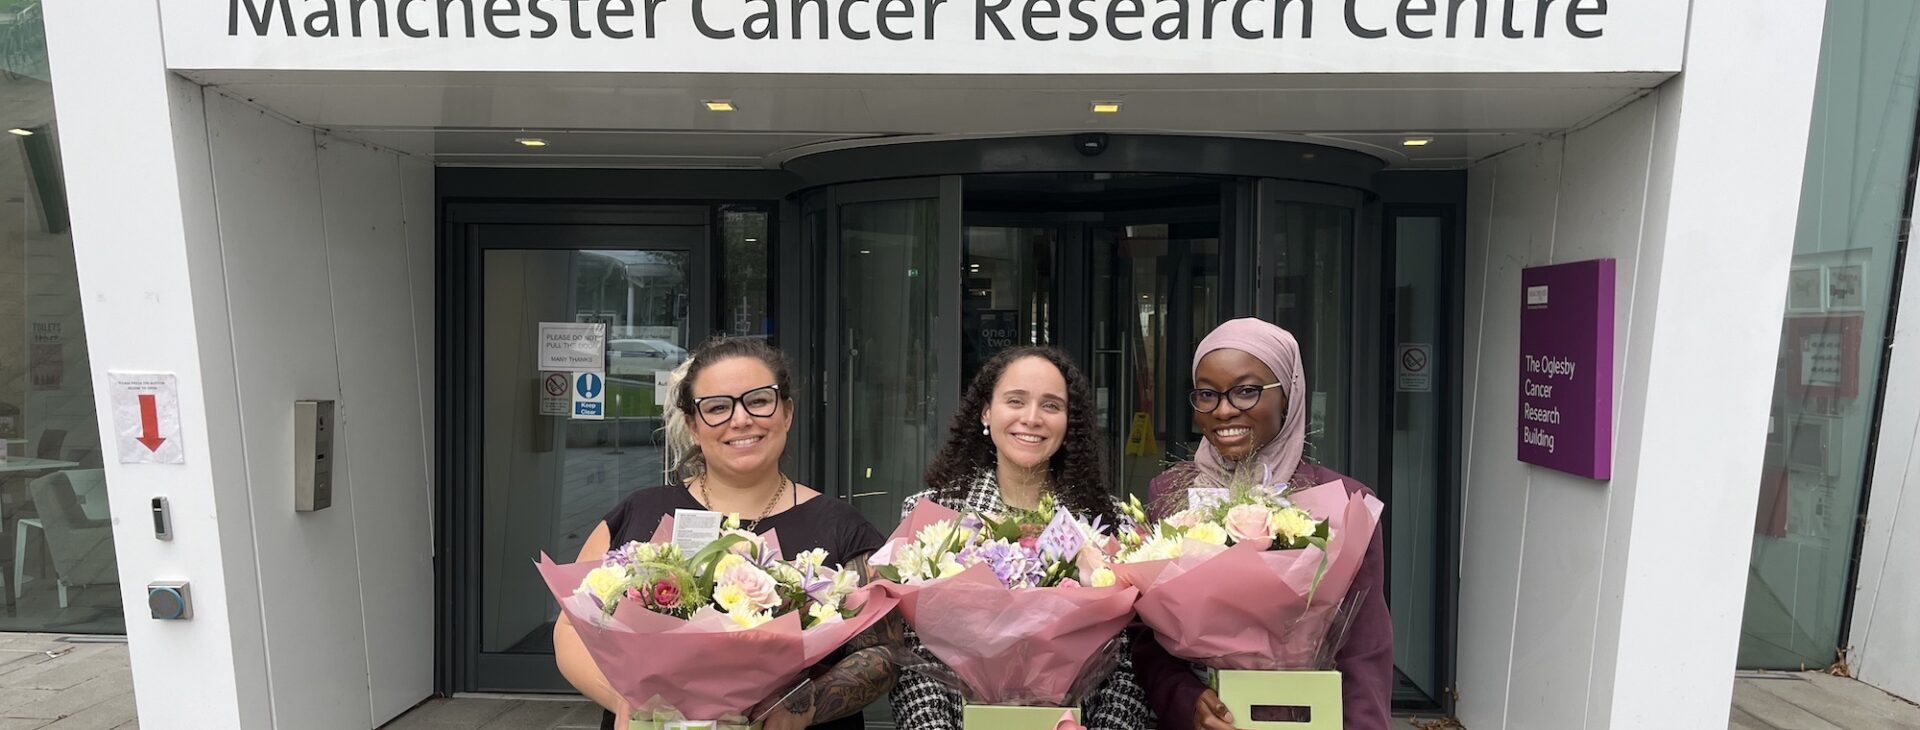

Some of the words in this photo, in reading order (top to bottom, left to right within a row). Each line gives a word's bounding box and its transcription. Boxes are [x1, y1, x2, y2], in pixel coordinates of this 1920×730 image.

[229, 0, 665, 39] Manchester
[692, 0, 947, 40] Cancer
[976, 0, 1312, 41] Research
[1344, 0, 1607, 39] Centre
[982, 328, 1005, 338] one
[987, 337, 1011, 347] two
[1525, 355, 1540, 373] The
[1541, 355, 1576, 380] Oglesby
[1524, 378, 1553, 398] Cancer
[1524, 402, 1560, 425] Research
[1523, 426, 1555, 453] Building
